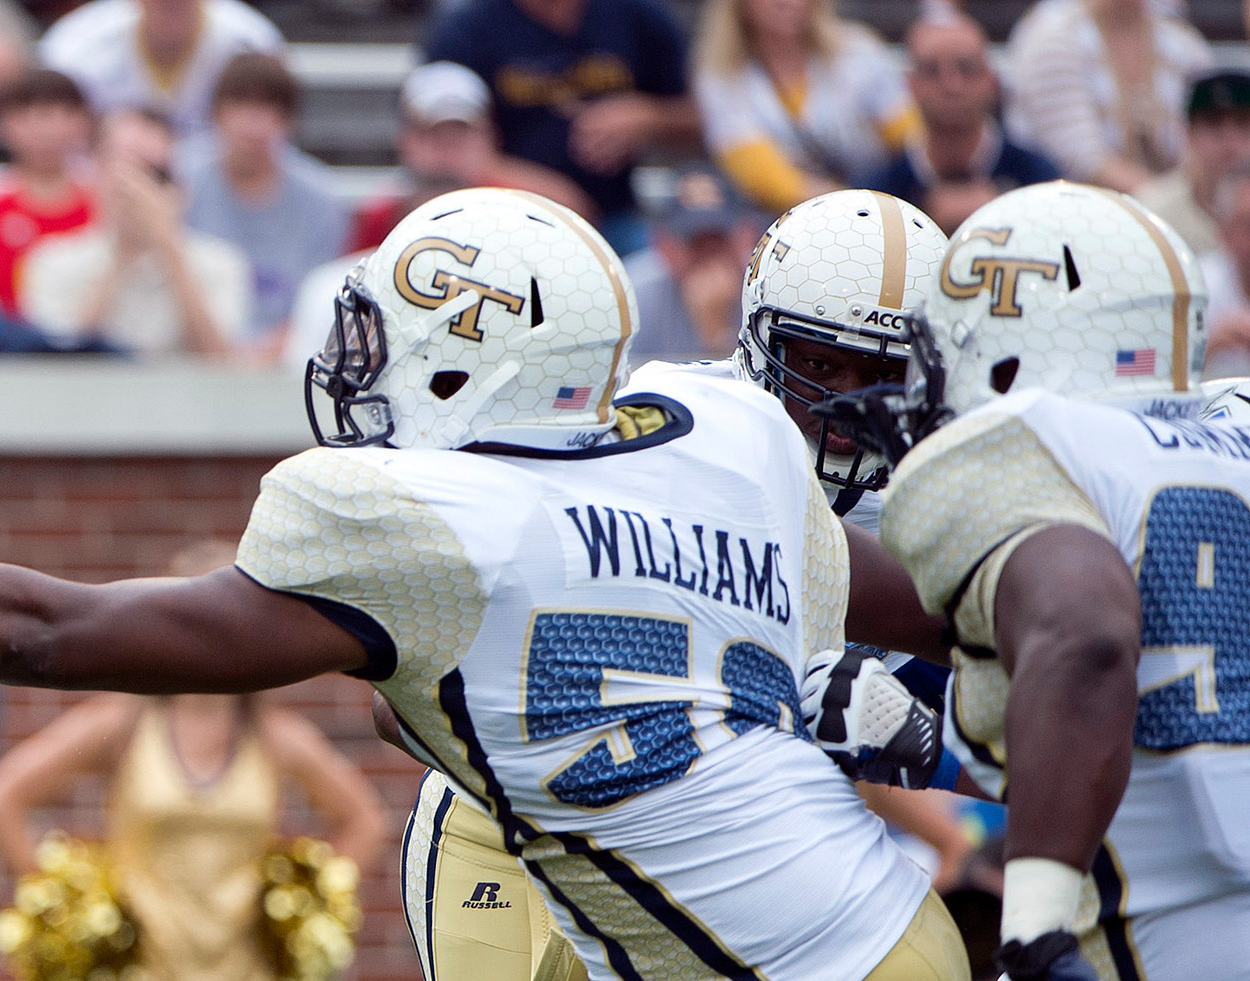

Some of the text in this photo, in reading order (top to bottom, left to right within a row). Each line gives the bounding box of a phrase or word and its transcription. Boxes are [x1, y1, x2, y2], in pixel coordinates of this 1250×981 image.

[393, 236, 526, 343] GT
[940, 227, 1060, 317] GT
[863, 310, 904, 330] ACC
[564, 505, 791, 625] WILLIAMS
[461, 900, 512, 909] RUSSELL
[469, 882, 501, 902] R
